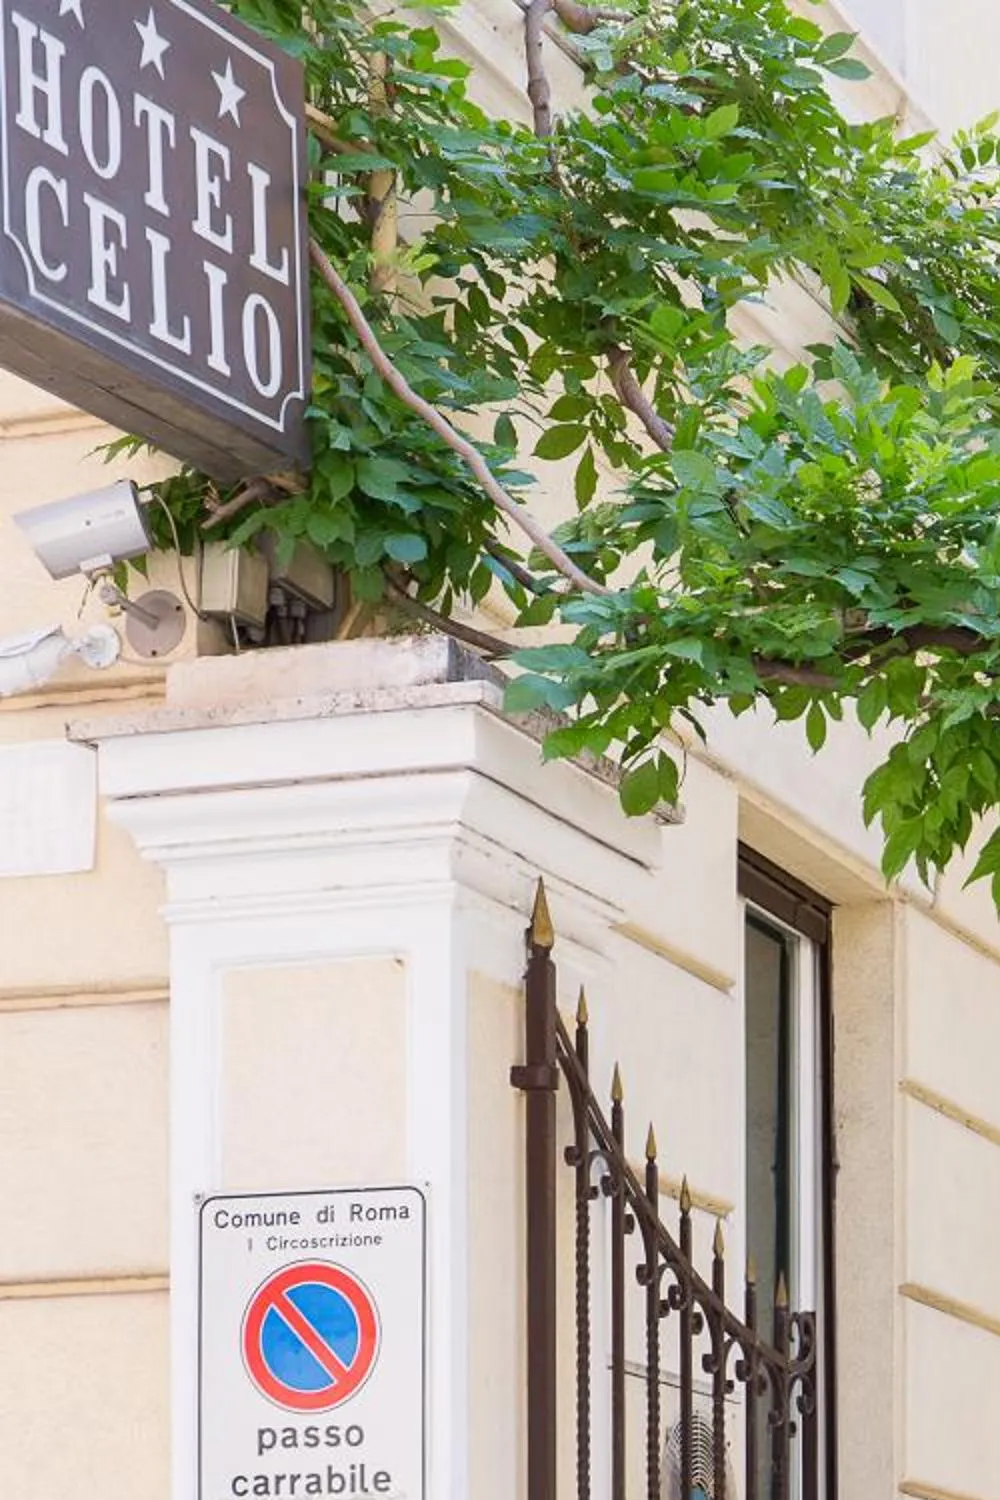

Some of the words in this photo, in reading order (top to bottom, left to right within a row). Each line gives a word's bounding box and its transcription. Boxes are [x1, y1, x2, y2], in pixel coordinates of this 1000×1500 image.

[12, 11, 289, 286] HOTEL
[25, 166, 282, 398] CELIO
[214, 1210, 300, 1229] Comune
[316, 1205, 335, 1223] di
[350, 1203, 410, 1222] Roma
[266, 1233, 383, 1251] Circoscrizione
[257, 1425, 365, 1456] passo
[231, 1464, 392, 1497] carrabile
